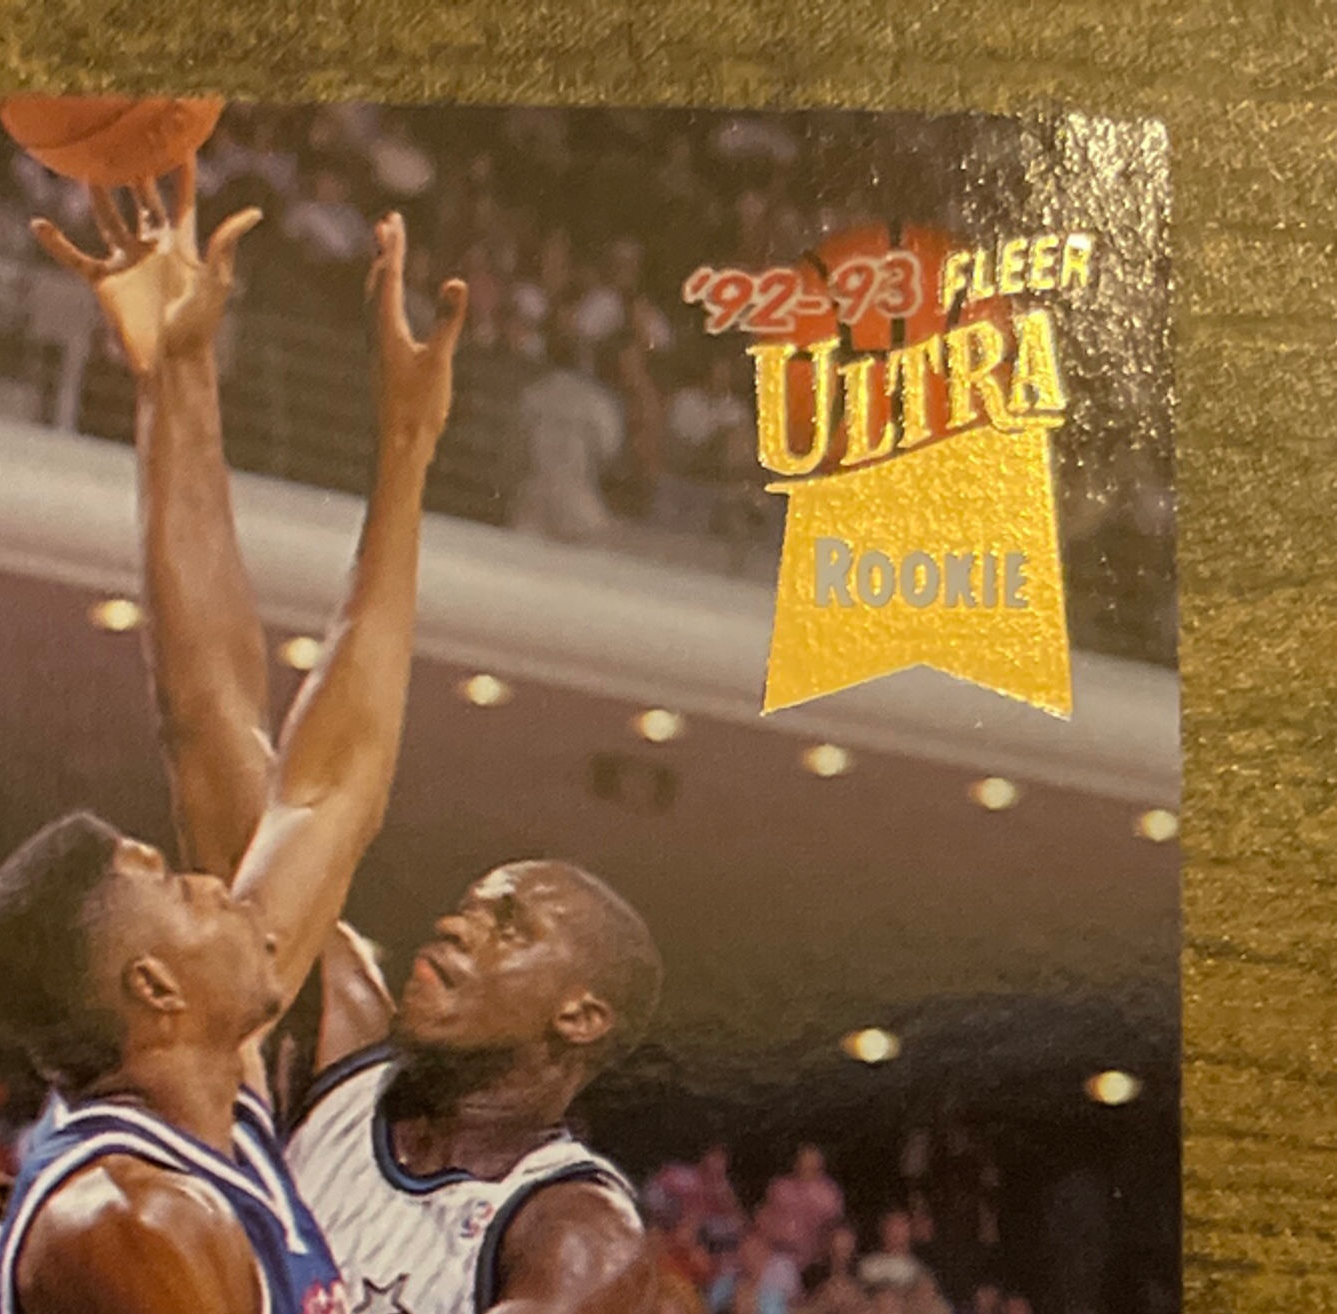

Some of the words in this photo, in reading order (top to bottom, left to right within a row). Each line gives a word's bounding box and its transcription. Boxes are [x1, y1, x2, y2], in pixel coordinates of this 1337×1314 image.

[937, 231, 1095, 312] FLEER
[745, 307, 1068, 478] ULTRA
[813, 535, 1029, 609] ROOKIE
